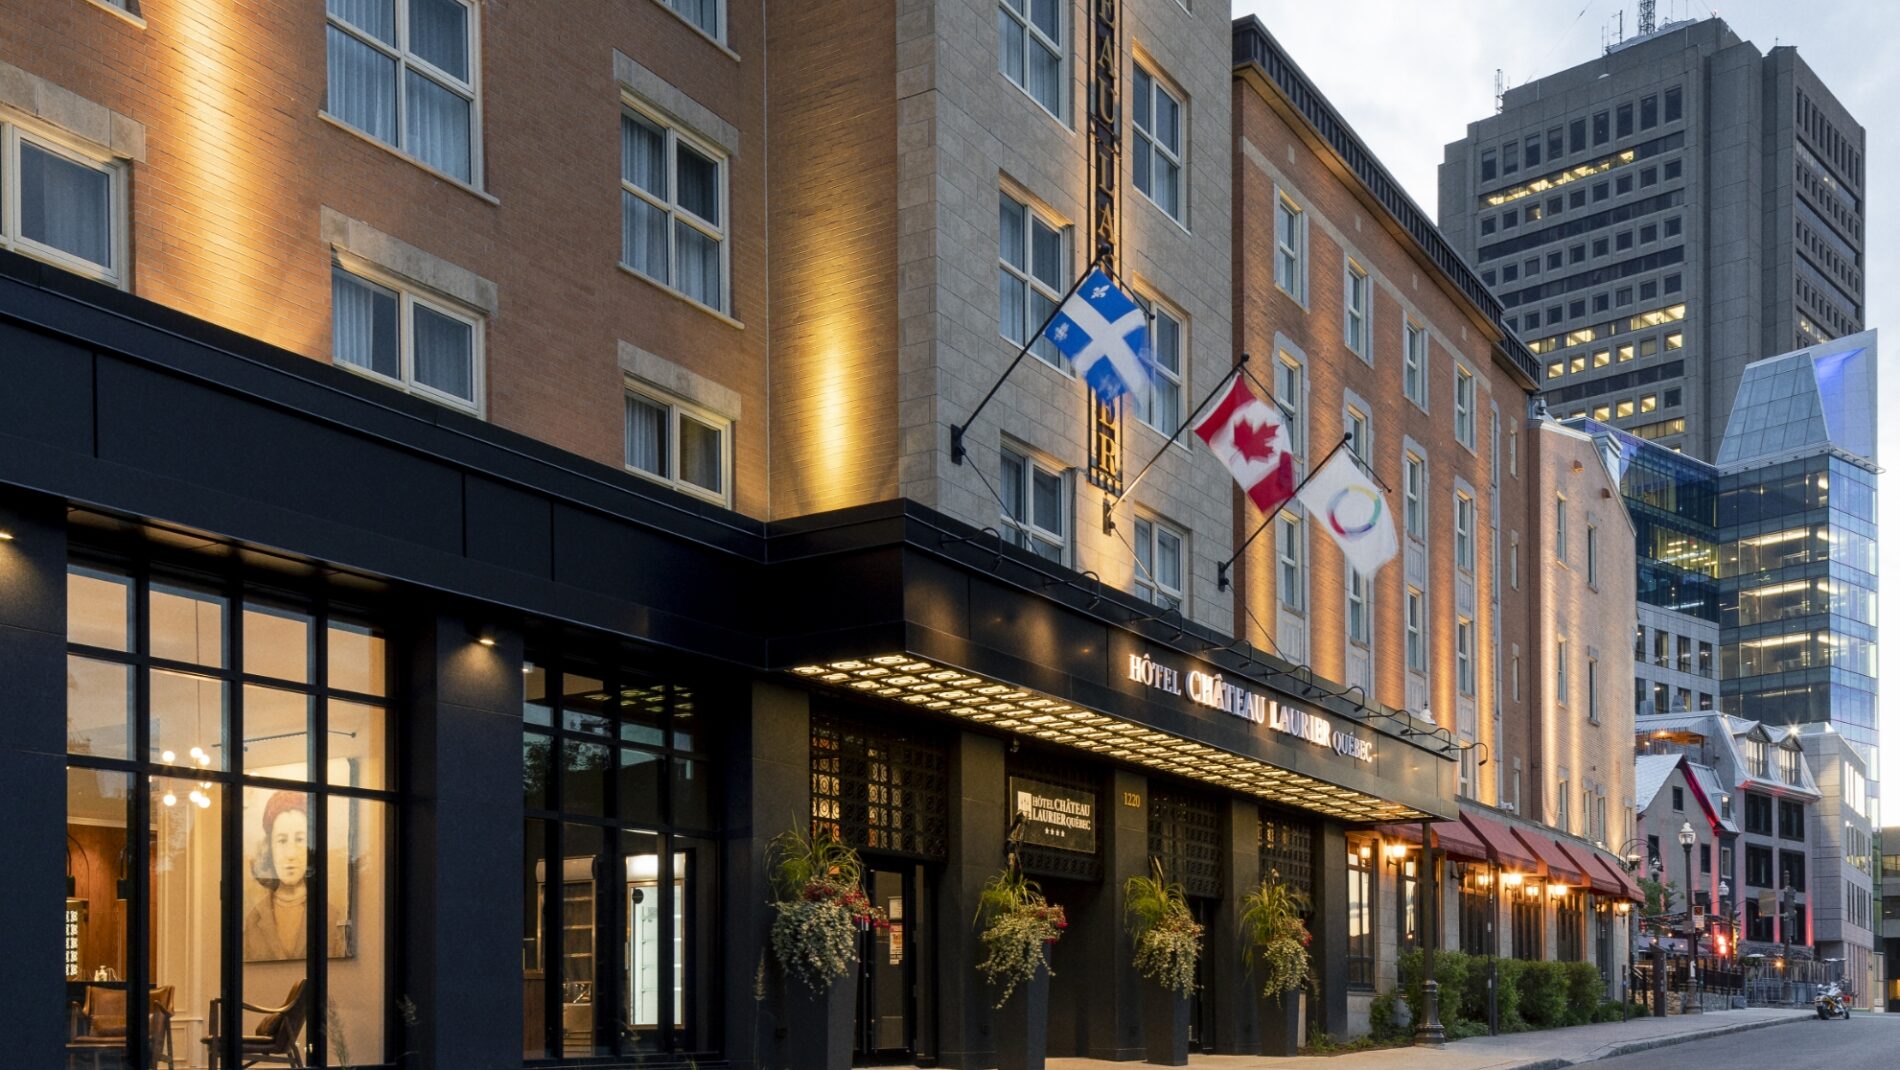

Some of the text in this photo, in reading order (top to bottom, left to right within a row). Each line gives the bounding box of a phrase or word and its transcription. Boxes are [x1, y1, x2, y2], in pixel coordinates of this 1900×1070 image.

[1128, 653, 1372, 763] HÔTEL CHÂTEAU LAURIER QUÉBEC
[1032, 795, 1091, 816] HÔTEL CHÂTEAU
[1123, 792, 1141, 808] 1220
[1032, 807, 1091, 830] LAURIER QUÉBEC
